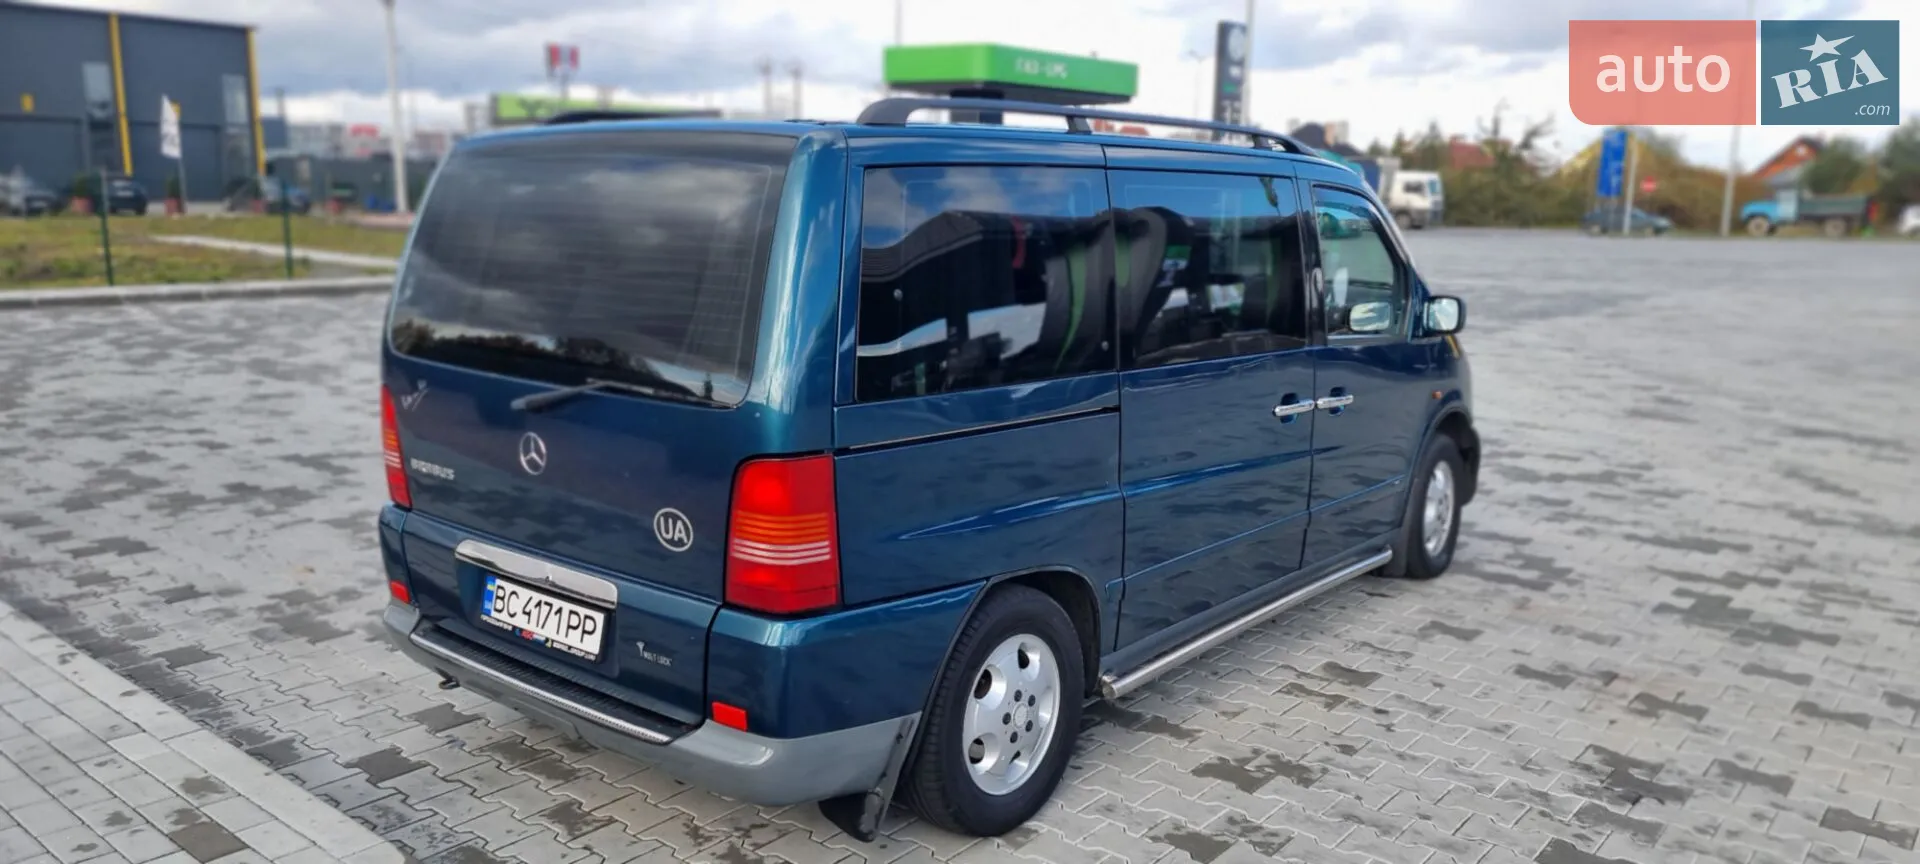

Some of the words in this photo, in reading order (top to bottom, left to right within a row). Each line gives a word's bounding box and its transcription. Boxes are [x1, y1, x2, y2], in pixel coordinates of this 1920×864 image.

[660, 515, 688, 544] UA
[493, 585, 519, 618] BC
[522, 596, 564, 636] 4171
[565, 610, 597, 643] PP
